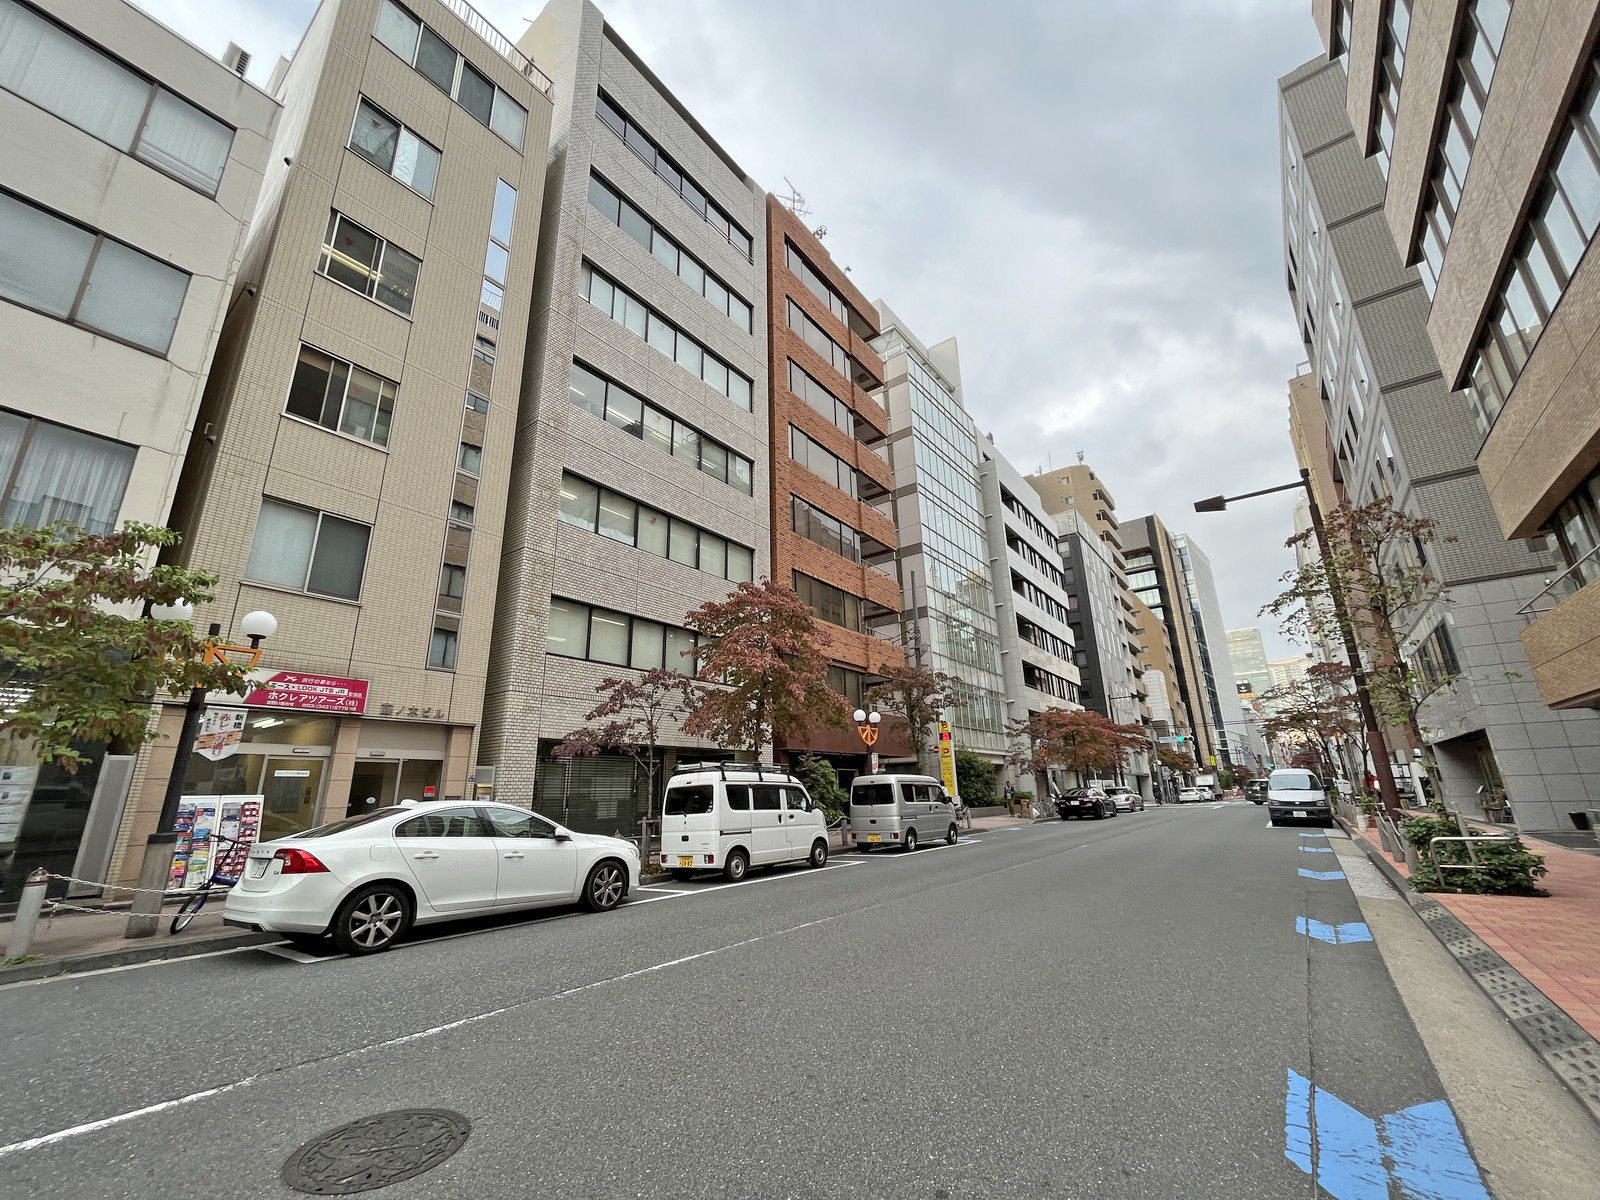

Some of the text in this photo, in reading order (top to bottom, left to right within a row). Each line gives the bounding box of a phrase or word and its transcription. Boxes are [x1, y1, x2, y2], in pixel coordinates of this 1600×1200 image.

[211, 713, 232, 757] 赤レンガ通り
[233, 713, 245, 729] 新橋
